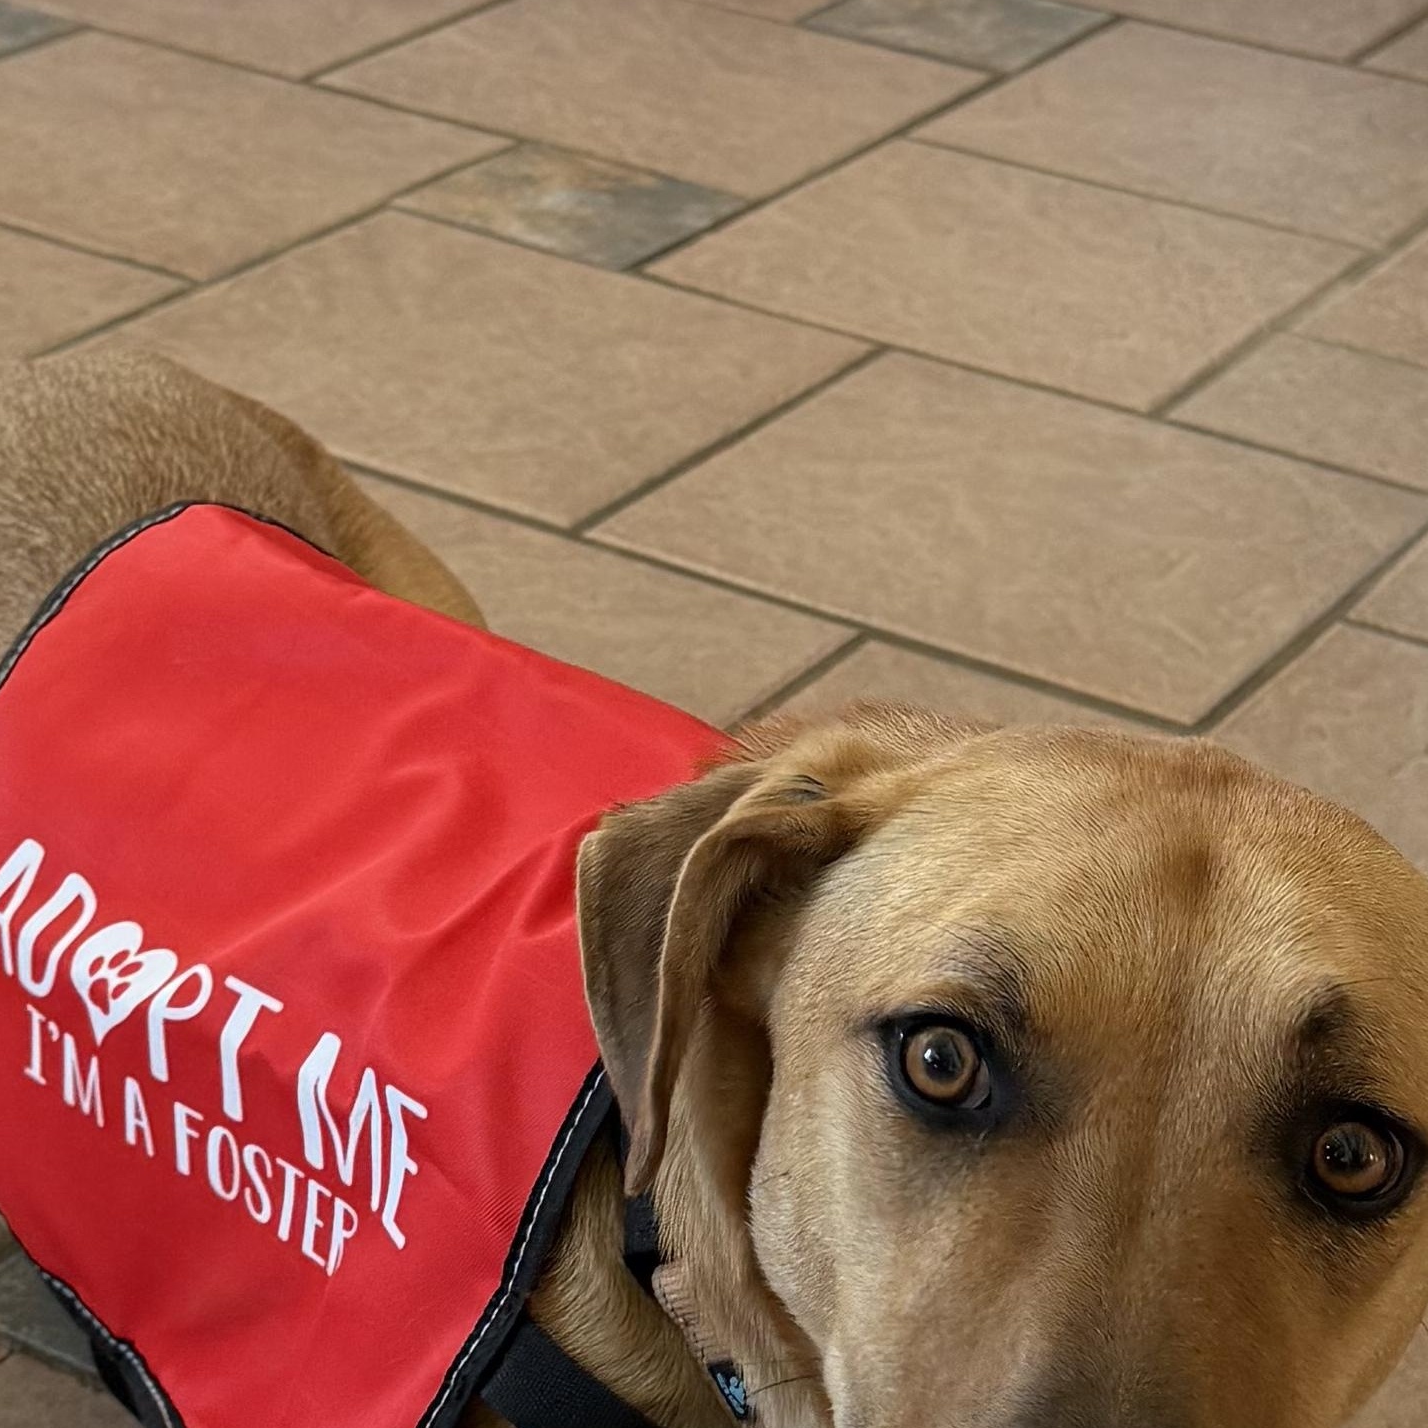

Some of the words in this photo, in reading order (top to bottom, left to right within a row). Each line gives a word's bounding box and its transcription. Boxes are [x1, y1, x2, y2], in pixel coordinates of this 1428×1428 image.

[23, 1003, 104, 1128] I'M
[123, 1076, 155, 1158] A
[173, 1100, 359, 1277] FOSTER
[296, 1031, 428, 1250] ME
